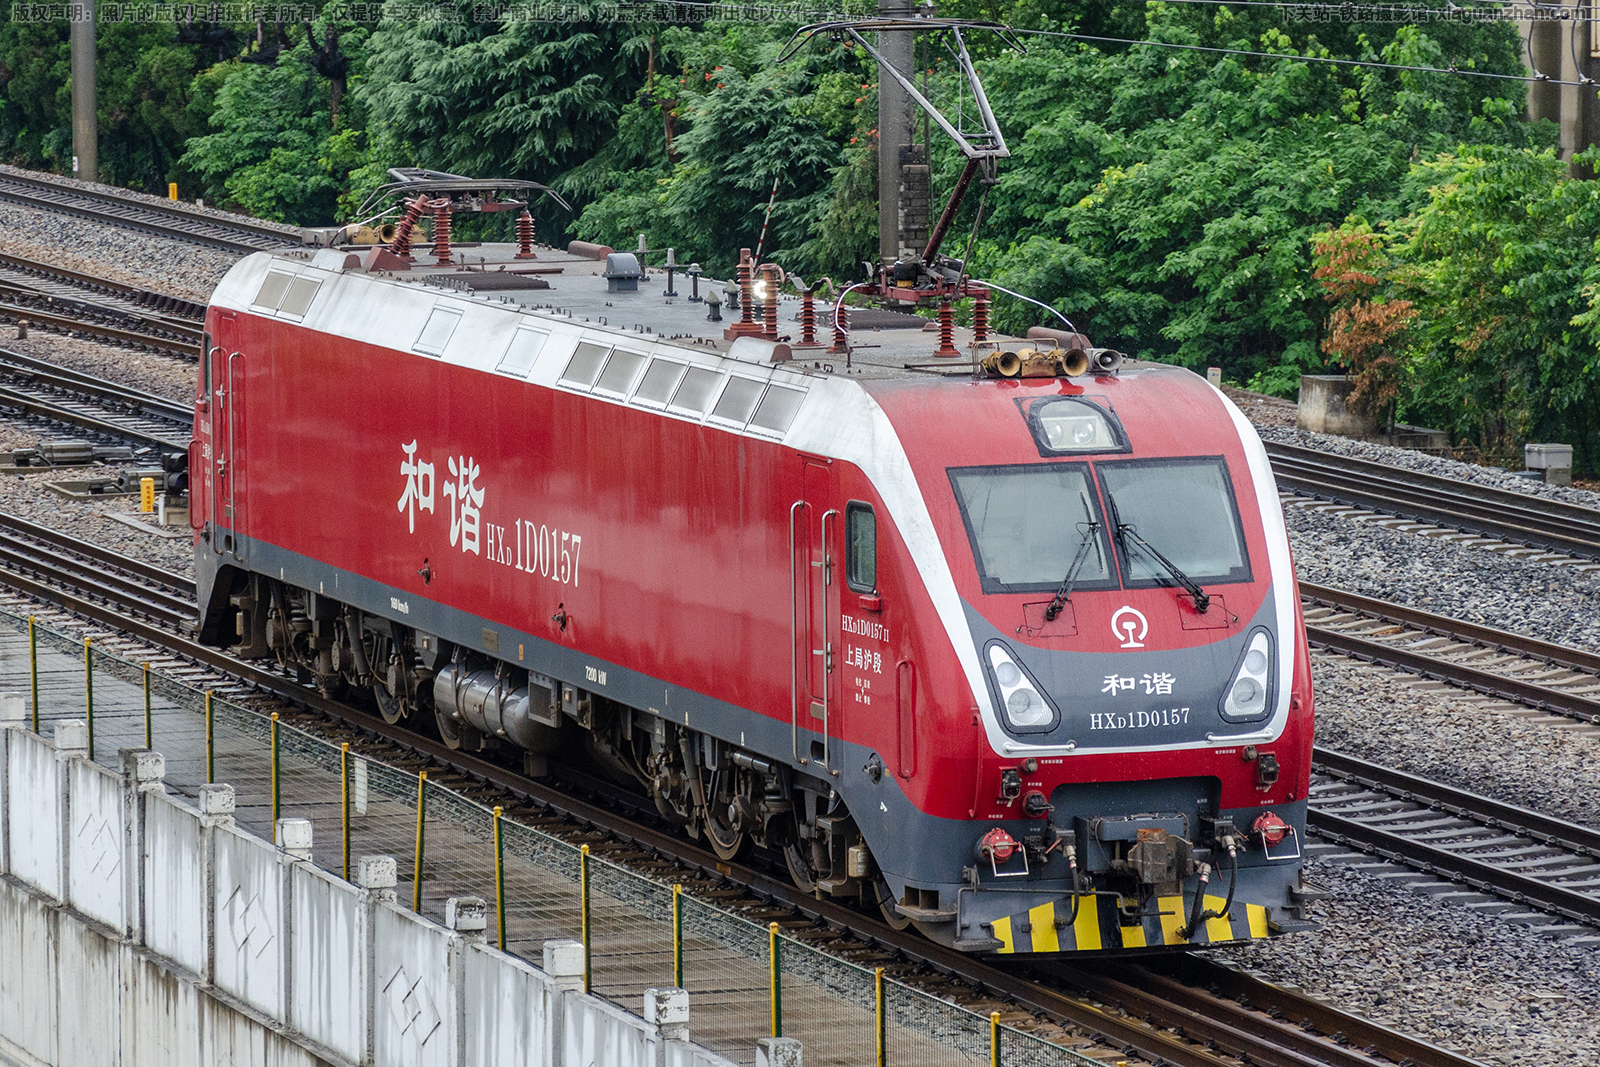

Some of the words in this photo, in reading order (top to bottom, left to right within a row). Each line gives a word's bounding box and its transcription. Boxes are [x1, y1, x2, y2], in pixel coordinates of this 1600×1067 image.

[397, 438, 485, 556] 和谐
[845, 643, 882, 674] 上局沪段
[1100, 671, 1177, 696] 和谐
